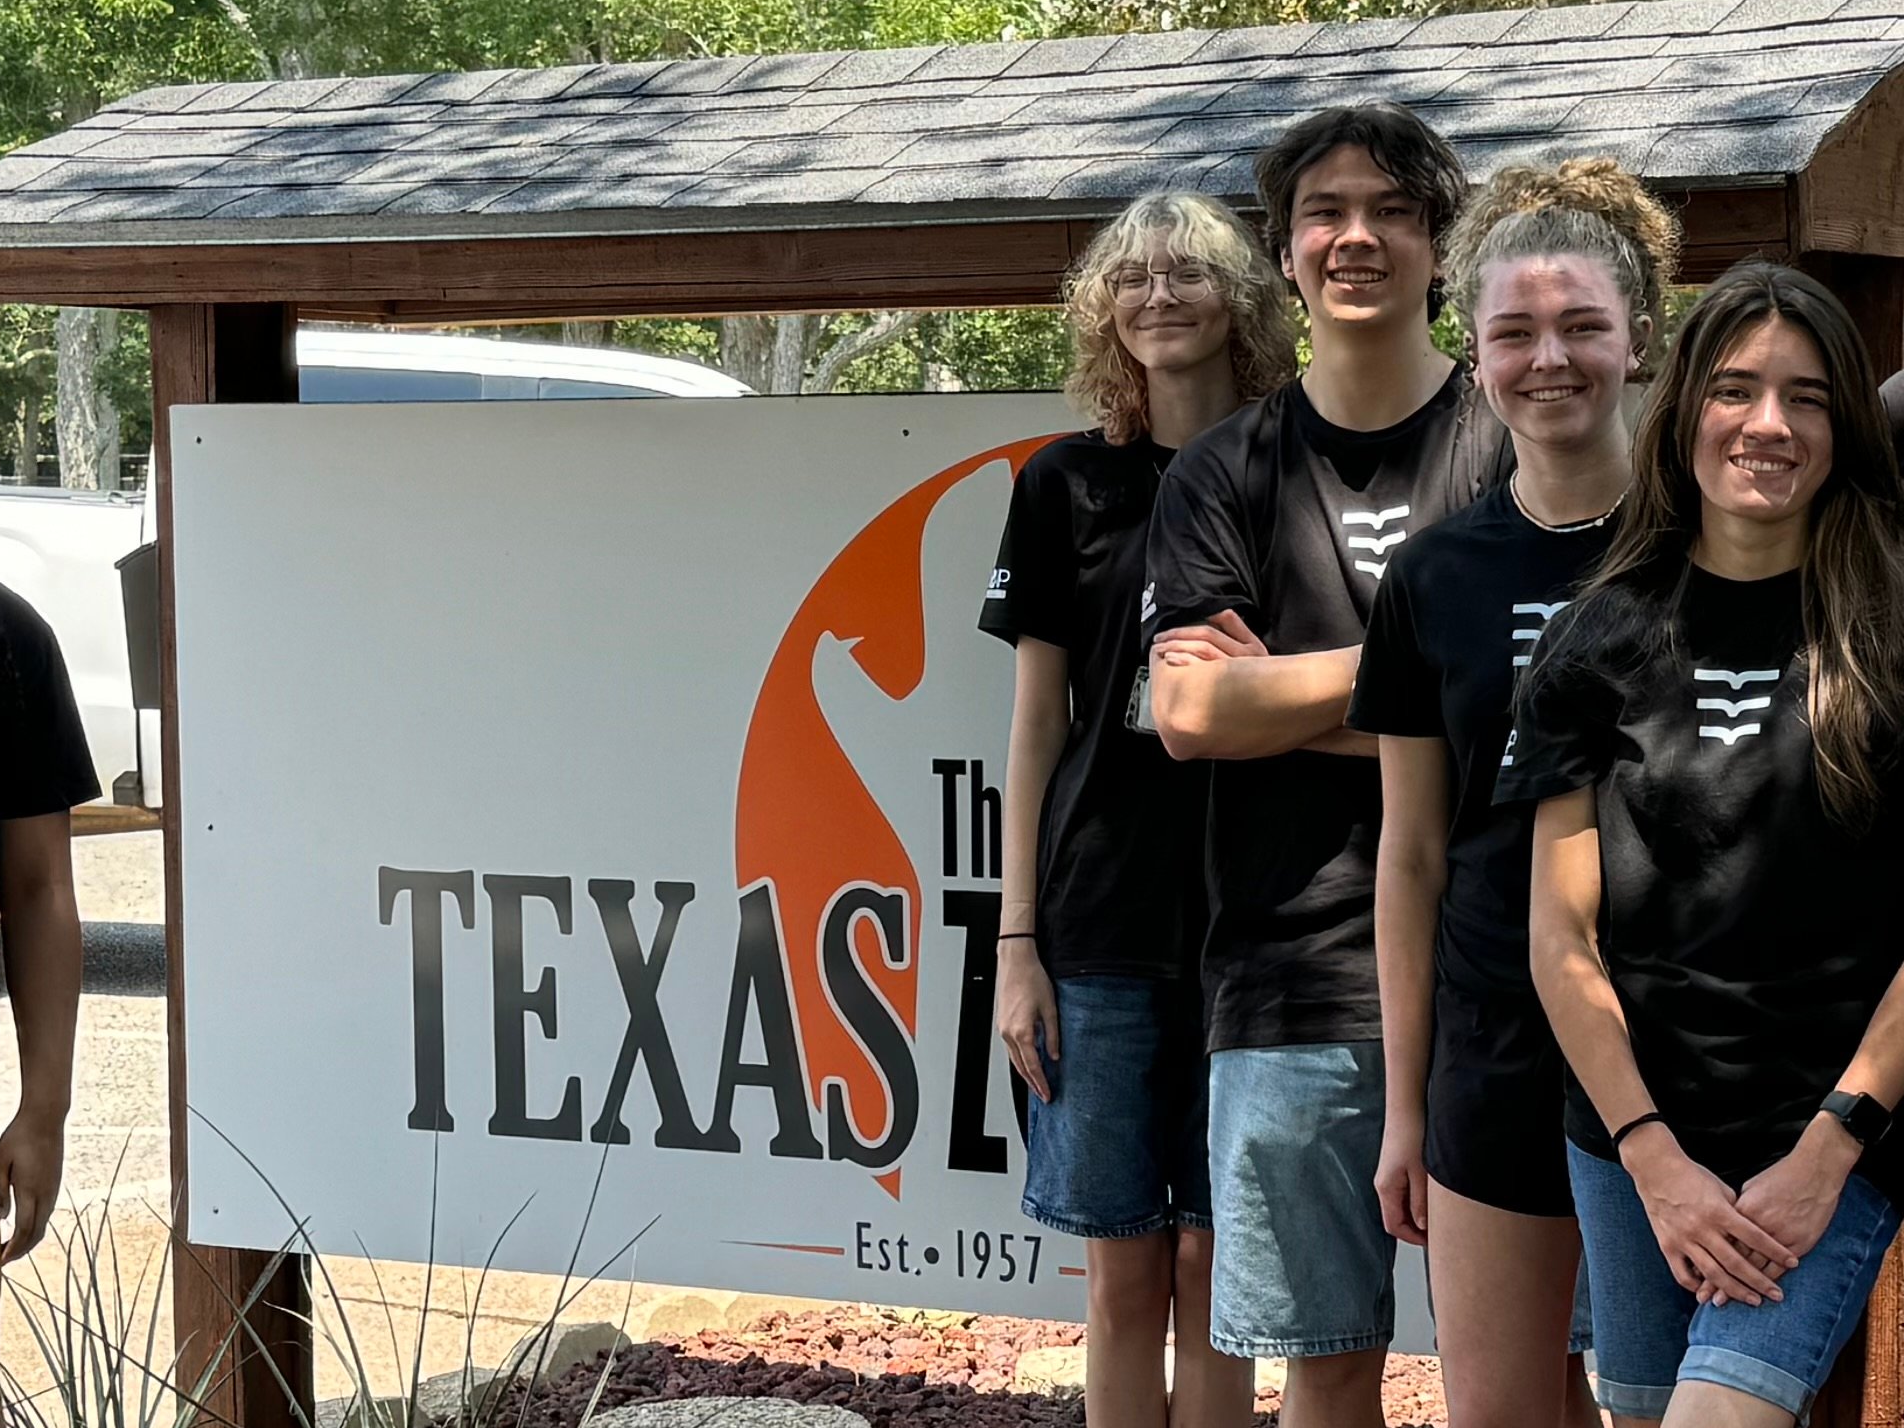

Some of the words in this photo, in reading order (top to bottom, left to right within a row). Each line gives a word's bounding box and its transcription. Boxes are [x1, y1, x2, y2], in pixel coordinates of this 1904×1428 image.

[378, 866, 919, 1168] TEXAS
[942, 888, 1028, 1174] Z
[957, 1229, 1042, 1285] 1957
